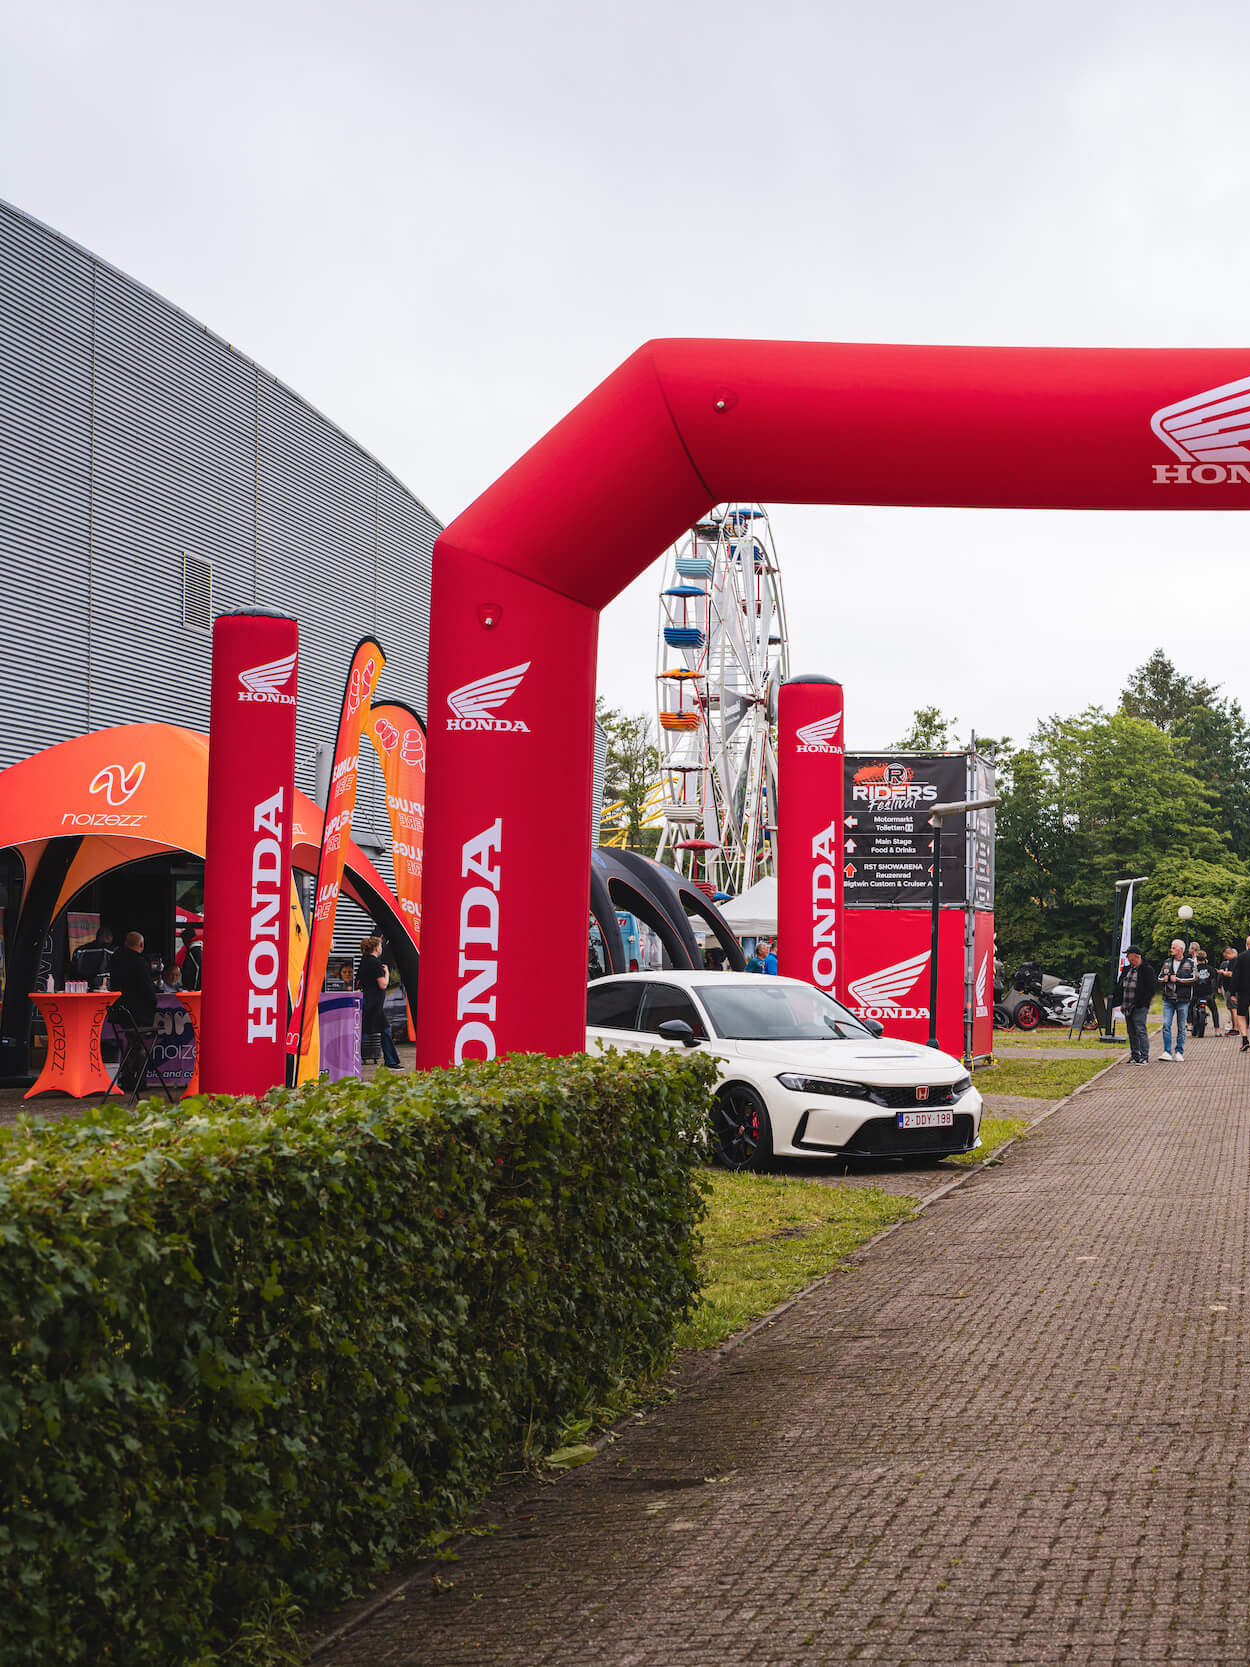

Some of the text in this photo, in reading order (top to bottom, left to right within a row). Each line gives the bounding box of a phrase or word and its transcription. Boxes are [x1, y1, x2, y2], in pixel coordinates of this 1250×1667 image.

[238, 692, 297, 705] HONDA
[446, 719, 531, 732] HONDA
[796, 744, 843, 754] HONDA
[852, 785, 938, 801] RIDERS
[868, 798, 917, 813] Festival
[892, 838, 912, 846] Stage
[247, 786, 284, 1043] HONDA
[454, 818, 503, 1067] ONDA
